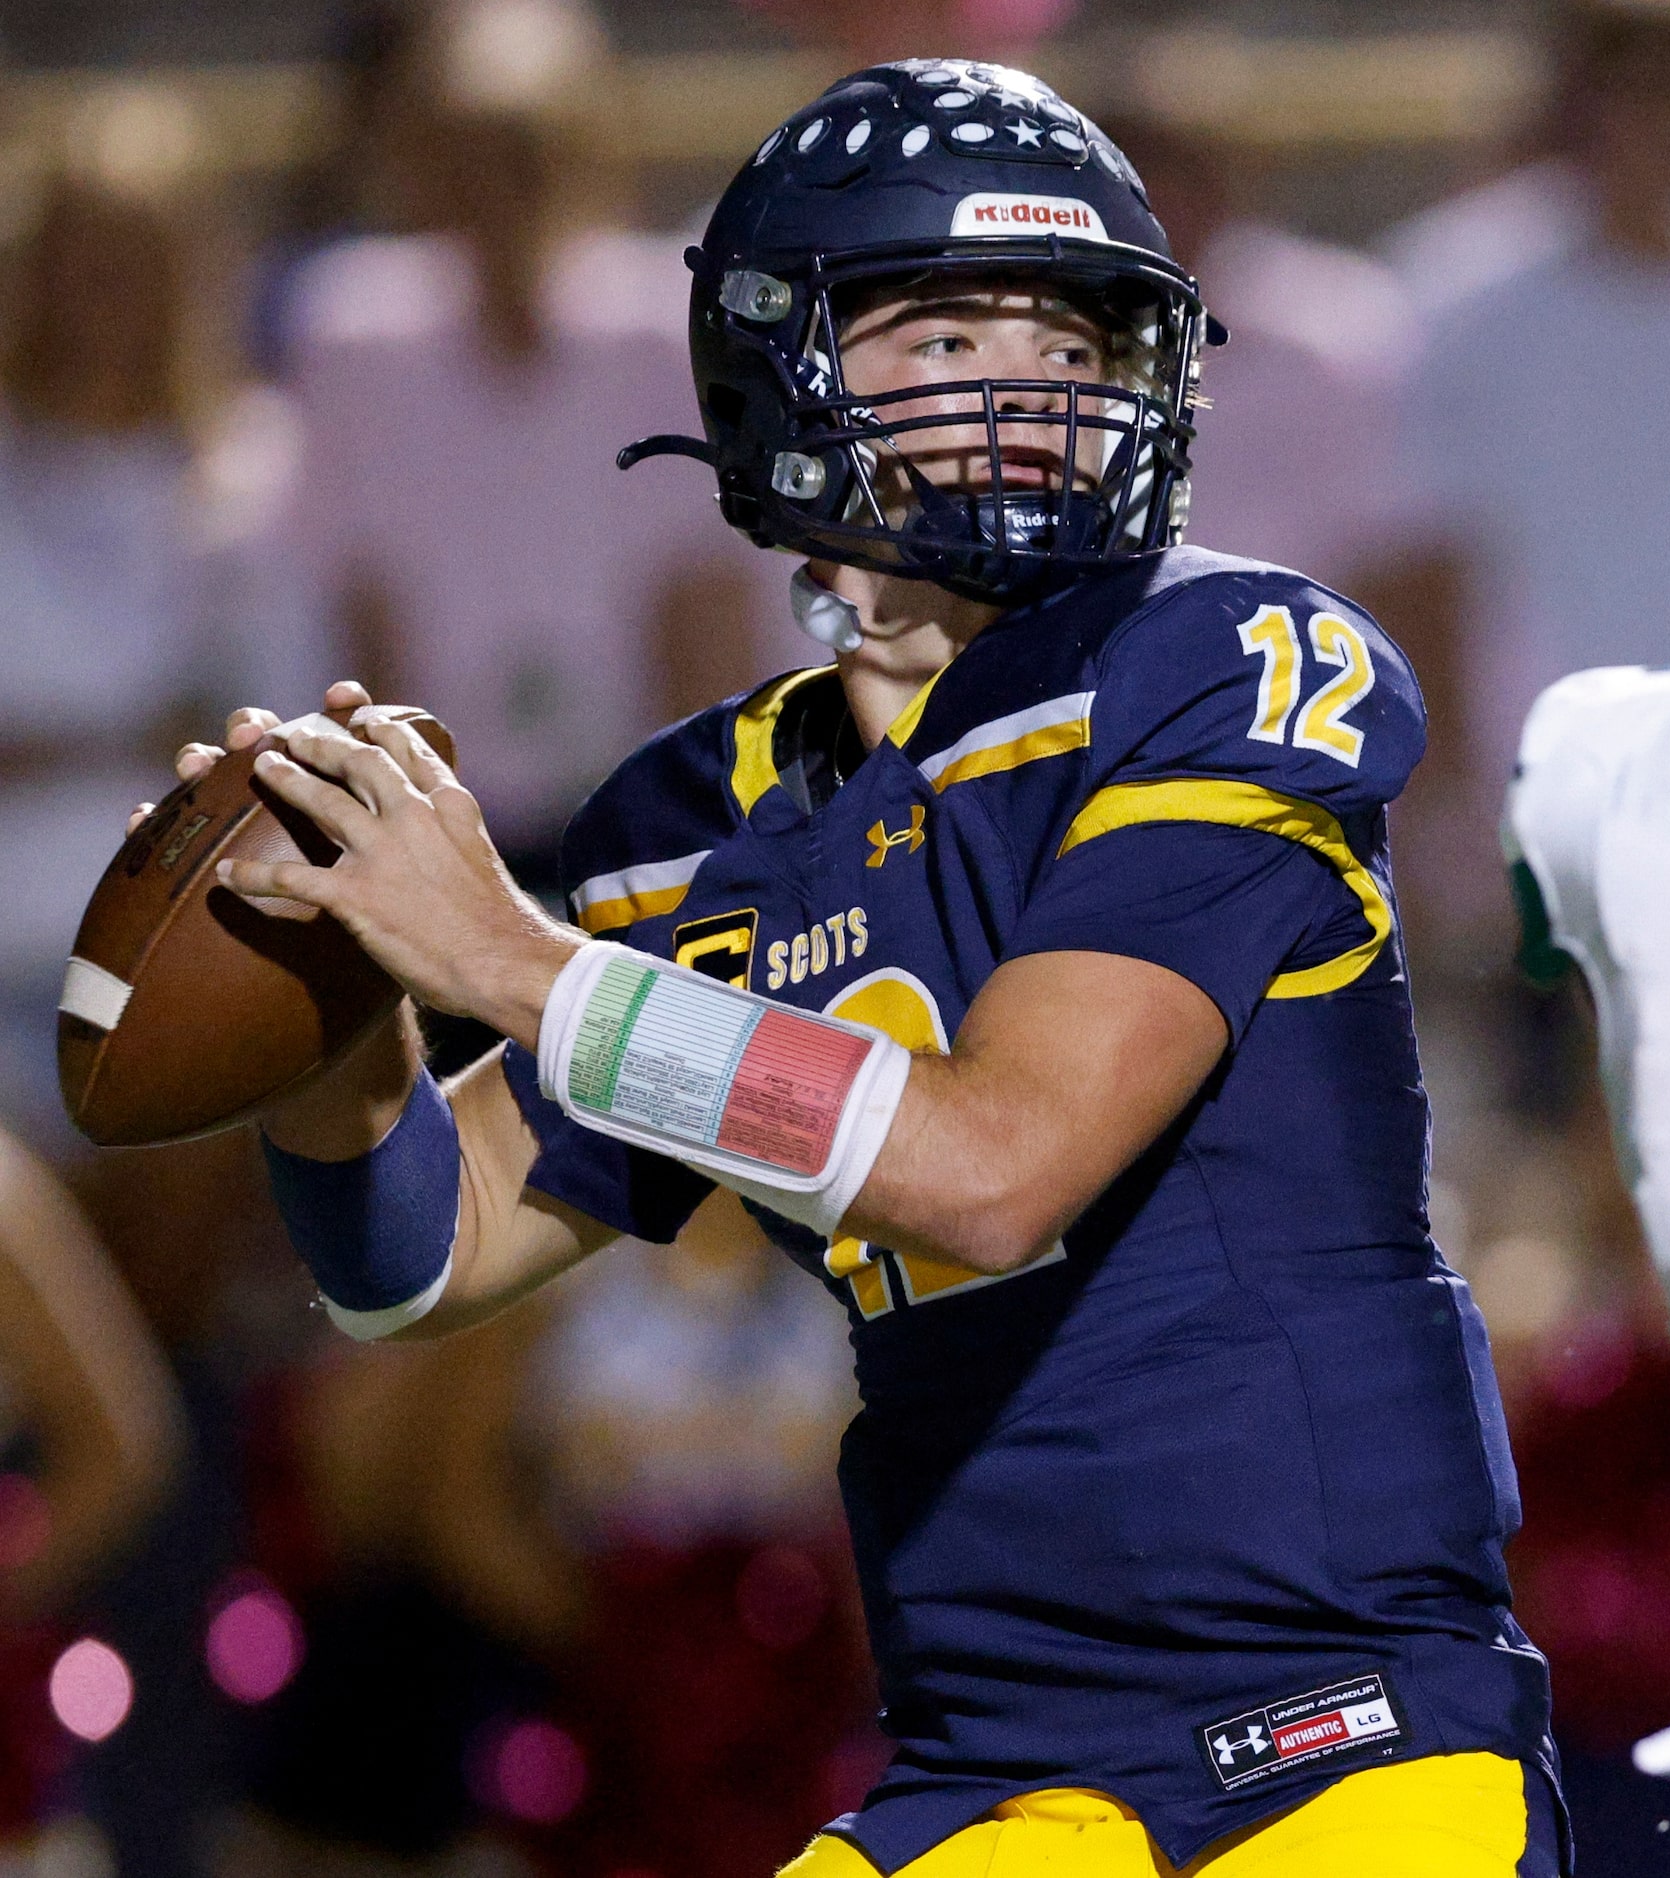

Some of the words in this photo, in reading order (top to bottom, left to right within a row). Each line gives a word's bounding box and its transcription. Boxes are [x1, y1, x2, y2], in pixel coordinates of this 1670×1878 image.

[1236, 604, 1375, 769] 12
[767, 906, 868, 991] SCOTS
[1273, 1701, 1315, 1722] UNDER
[1317, 1683, 1377, 1708] ARMOUR
[1279, 1720, 1343, 1750] AUTHENTIC
[1357, 1712, 1382, 1727] LG
[1225, 1771, 1270, 1792] UNIVERSAL
[1270, 1752, 1321, 1774] GUARANTEE
[1322, 1747, 1334, 1757] OF
[1336, 1729, 1401, 1752] PERFORMANCE
